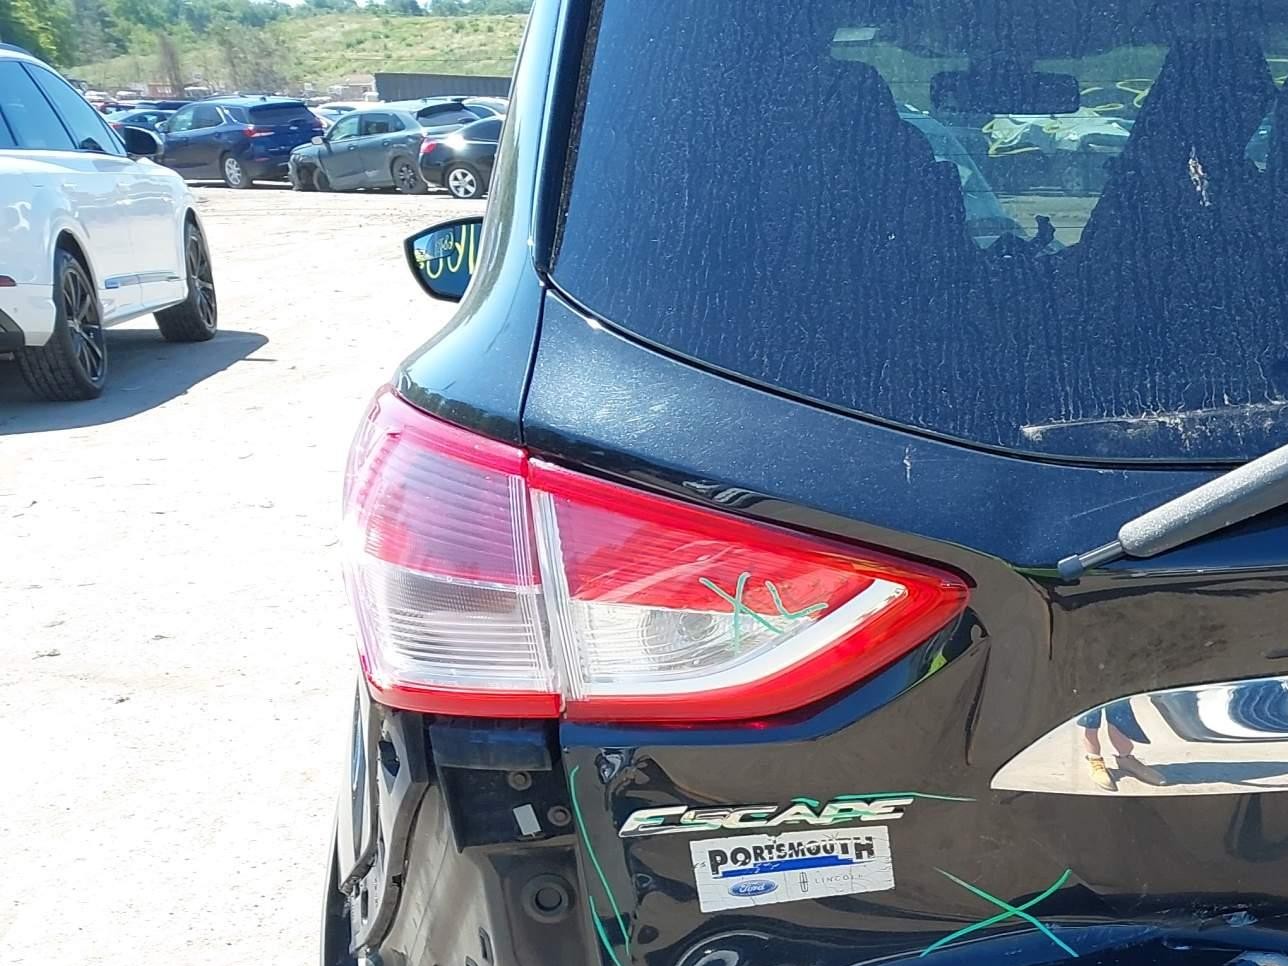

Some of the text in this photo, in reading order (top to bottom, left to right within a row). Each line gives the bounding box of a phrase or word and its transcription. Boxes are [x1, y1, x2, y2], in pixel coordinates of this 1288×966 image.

[618, 798, 914, 837] ESCAPE
[708, 836, 875, 876] PORTSMOUTH
[738, 880, 766, 893] Ford
